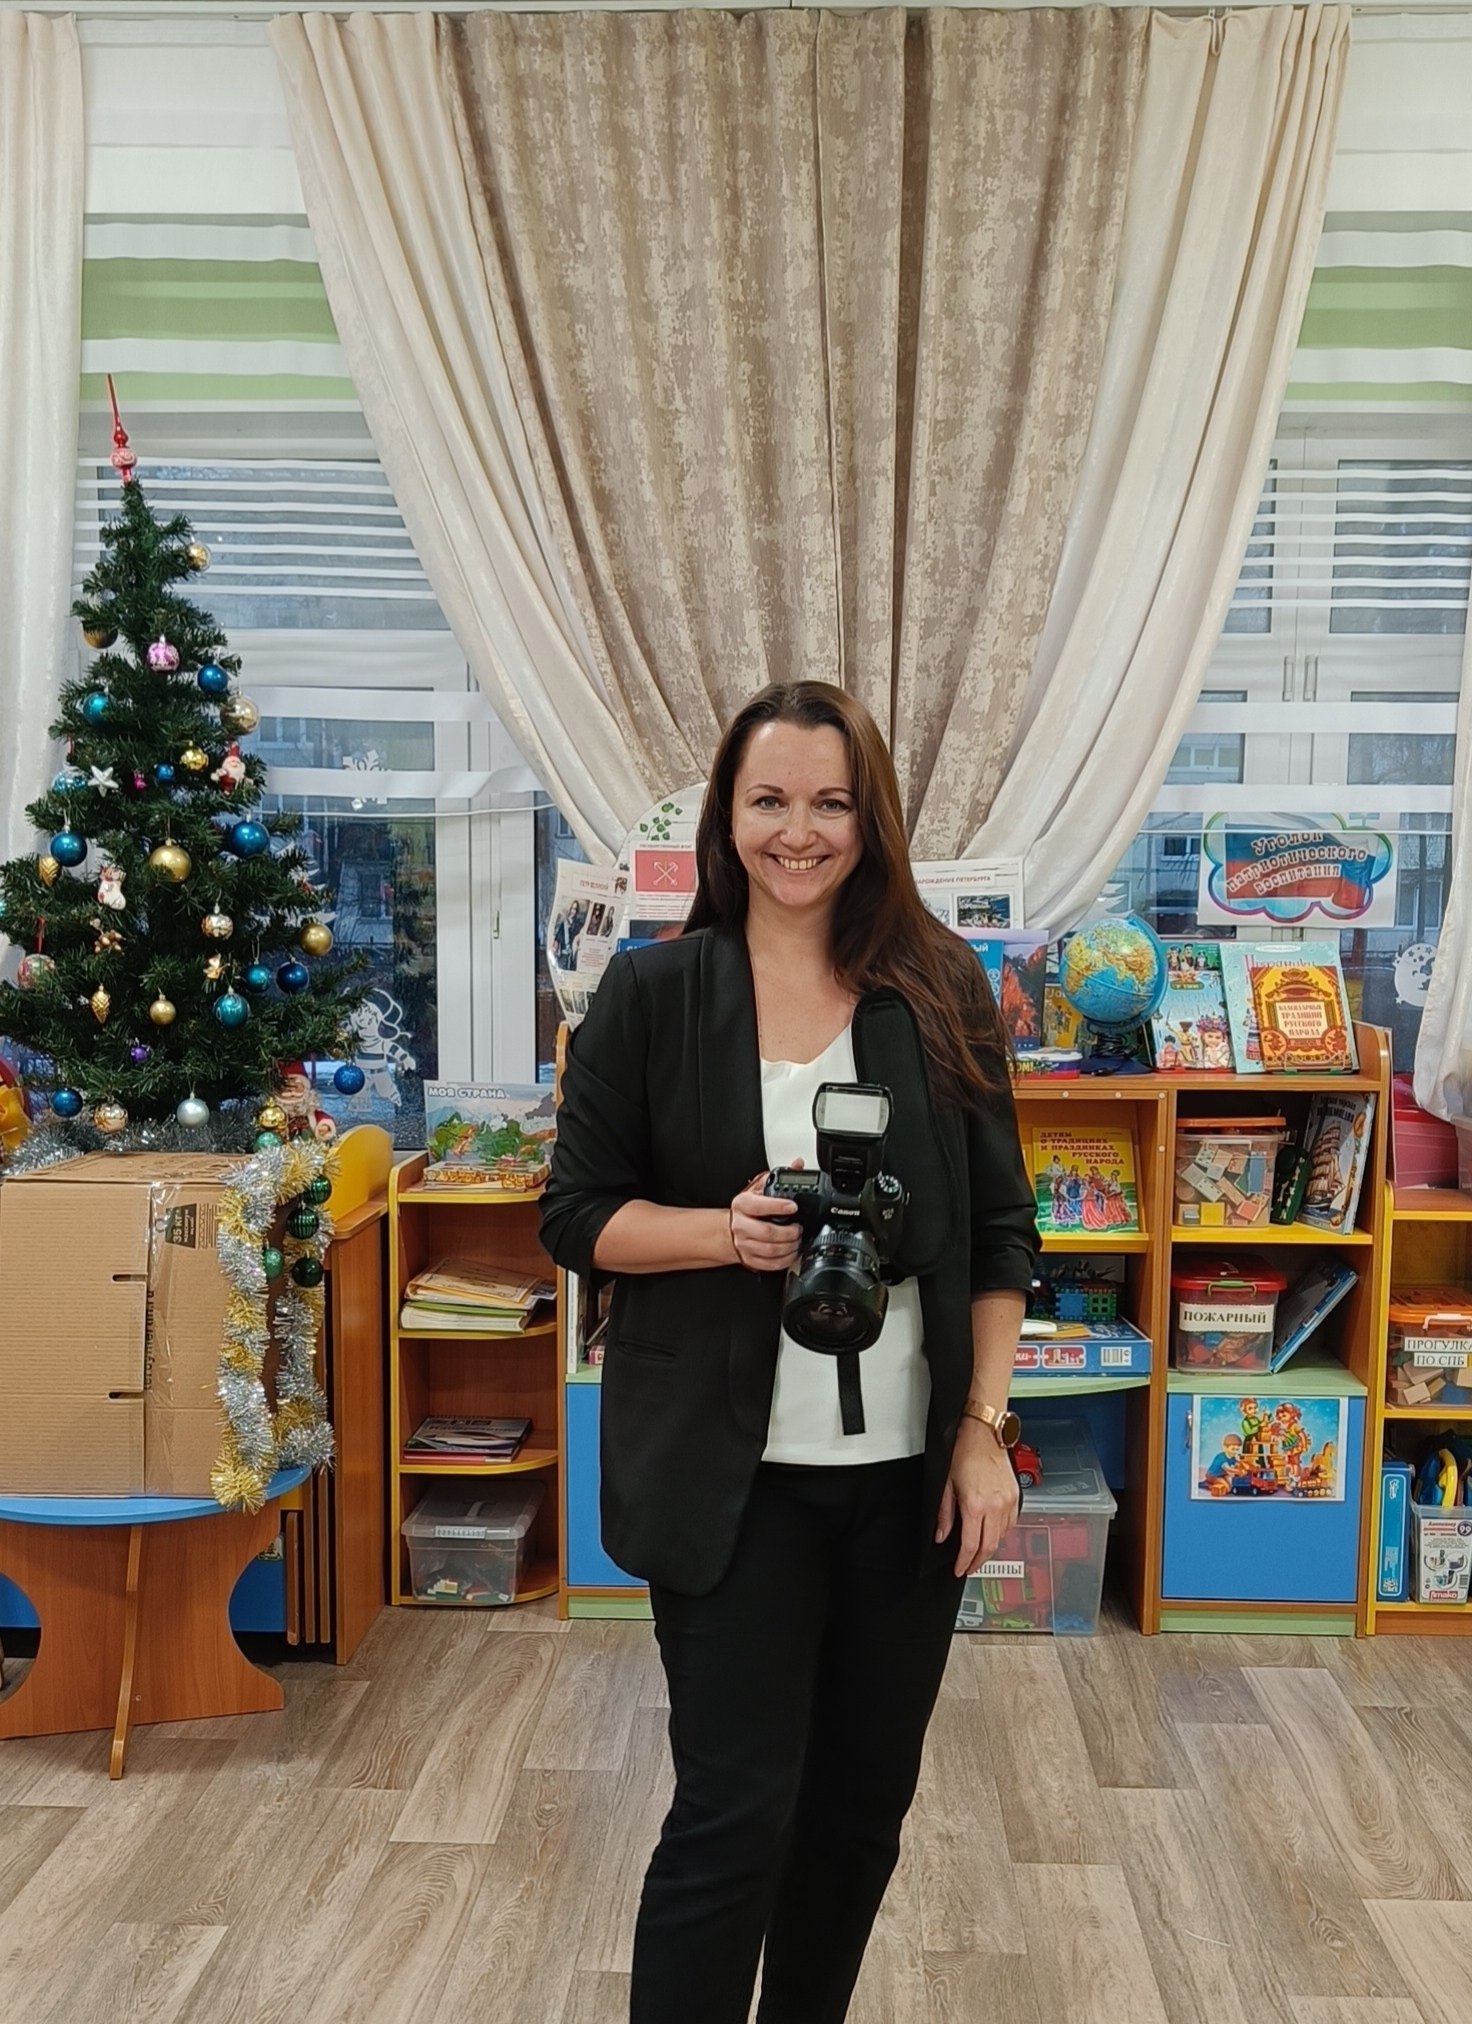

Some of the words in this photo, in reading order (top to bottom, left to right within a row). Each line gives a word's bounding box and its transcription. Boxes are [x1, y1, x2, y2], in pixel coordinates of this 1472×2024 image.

[1253, 832, 1322, 853] Уголок
[1227, 847, 1366, 891] патриотического
[916, 877, 954, 885] АРОЖДЕНИЕ
[956, 875, 991, 883] ПЕТЕРБУРГА
[1255, 865, 1340, 893] воспитания
[1284, 1019, 1321, 1027] РУССКОГО
[1288, 1028, 1320, 1036] НАРОДА
[429, 1086, 455, 1097] МОЯ
[458, 1087, 506, 1099] СТРАНА
[830, 1206, 860, 1216] Canon
[172, 1228, 183, 1243] 35
[1183, 1310, 1267, 1324] ПОЖАРНЫЙ
[1407, 1339, 1472, 1351] ПРОГУЛК
[1416, 1355, 1435, 1365] ПО
[1439, 1355, 1465, 1366] СПБ
